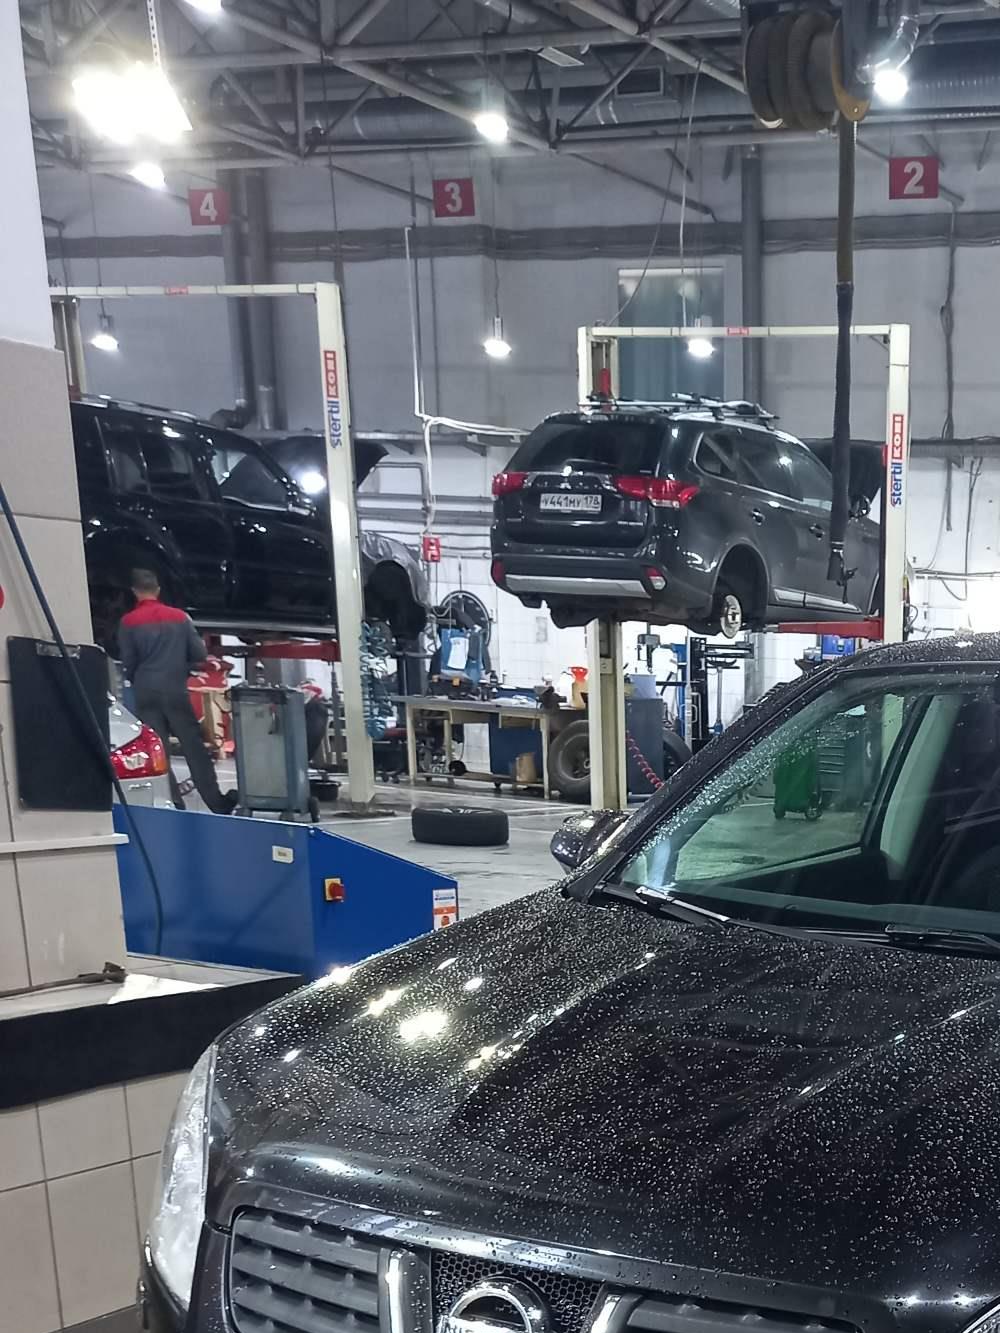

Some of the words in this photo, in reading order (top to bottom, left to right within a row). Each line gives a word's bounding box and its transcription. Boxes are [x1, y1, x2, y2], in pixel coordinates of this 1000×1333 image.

[903, 161, 925, 195] 2
[200, 192, 218, 222] 4
[446, 182, 463, 214] 3
[327, 400, 342, 448] stertil
[891, 462, 903, 507] stertil
